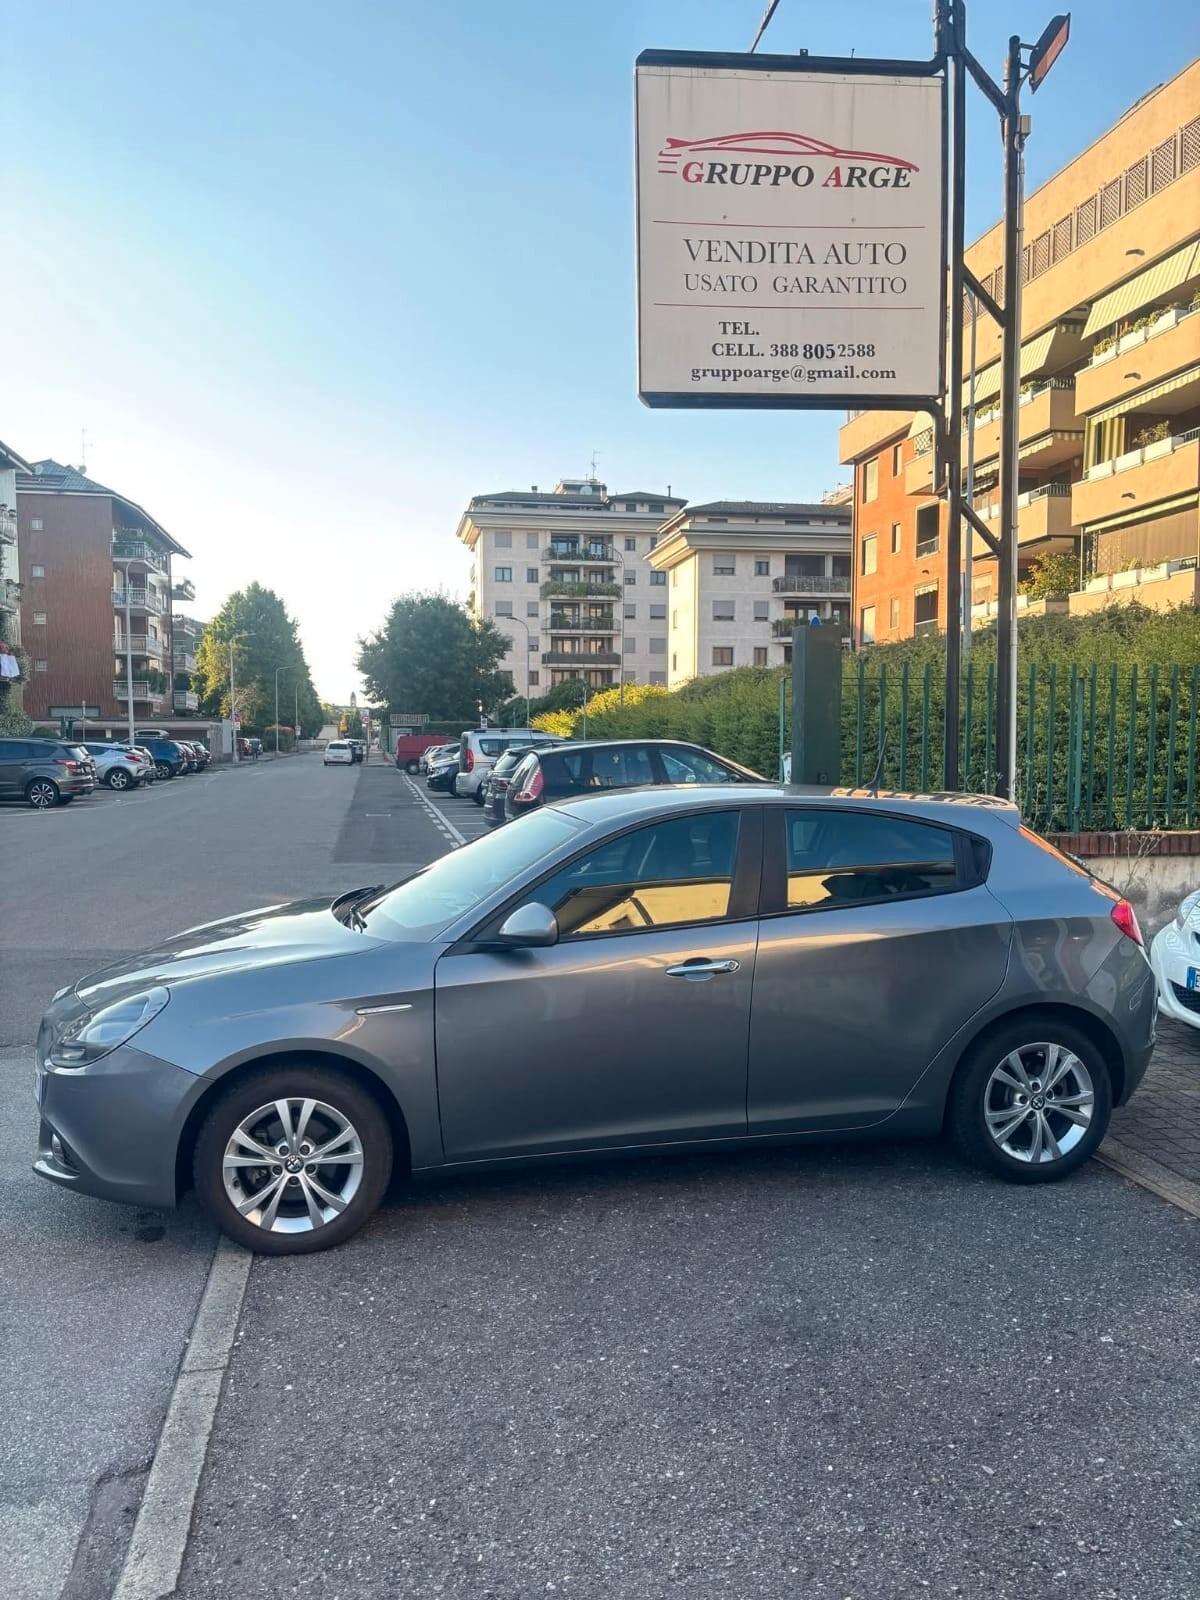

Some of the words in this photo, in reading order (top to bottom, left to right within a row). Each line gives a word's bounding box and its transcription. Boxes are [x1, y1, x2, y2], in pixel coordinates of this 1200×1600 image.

[682, 161, 815, 187] GRUPPO
[821, 165, 912, 188] ARGE
[683, 239, 815, 264] VENDITA
[823, 242, 907, 265] AUTO
[684, 273, 758, 293] USATO
[772, 276, 907, 294] GARANTITO
[718, 321, 760, 336] TEL.
[711, 342, 764, 357] CELL.
[770, 343, 799, 358] 388
[691, 365, 897, 382] gruppoarge@gmail.com
